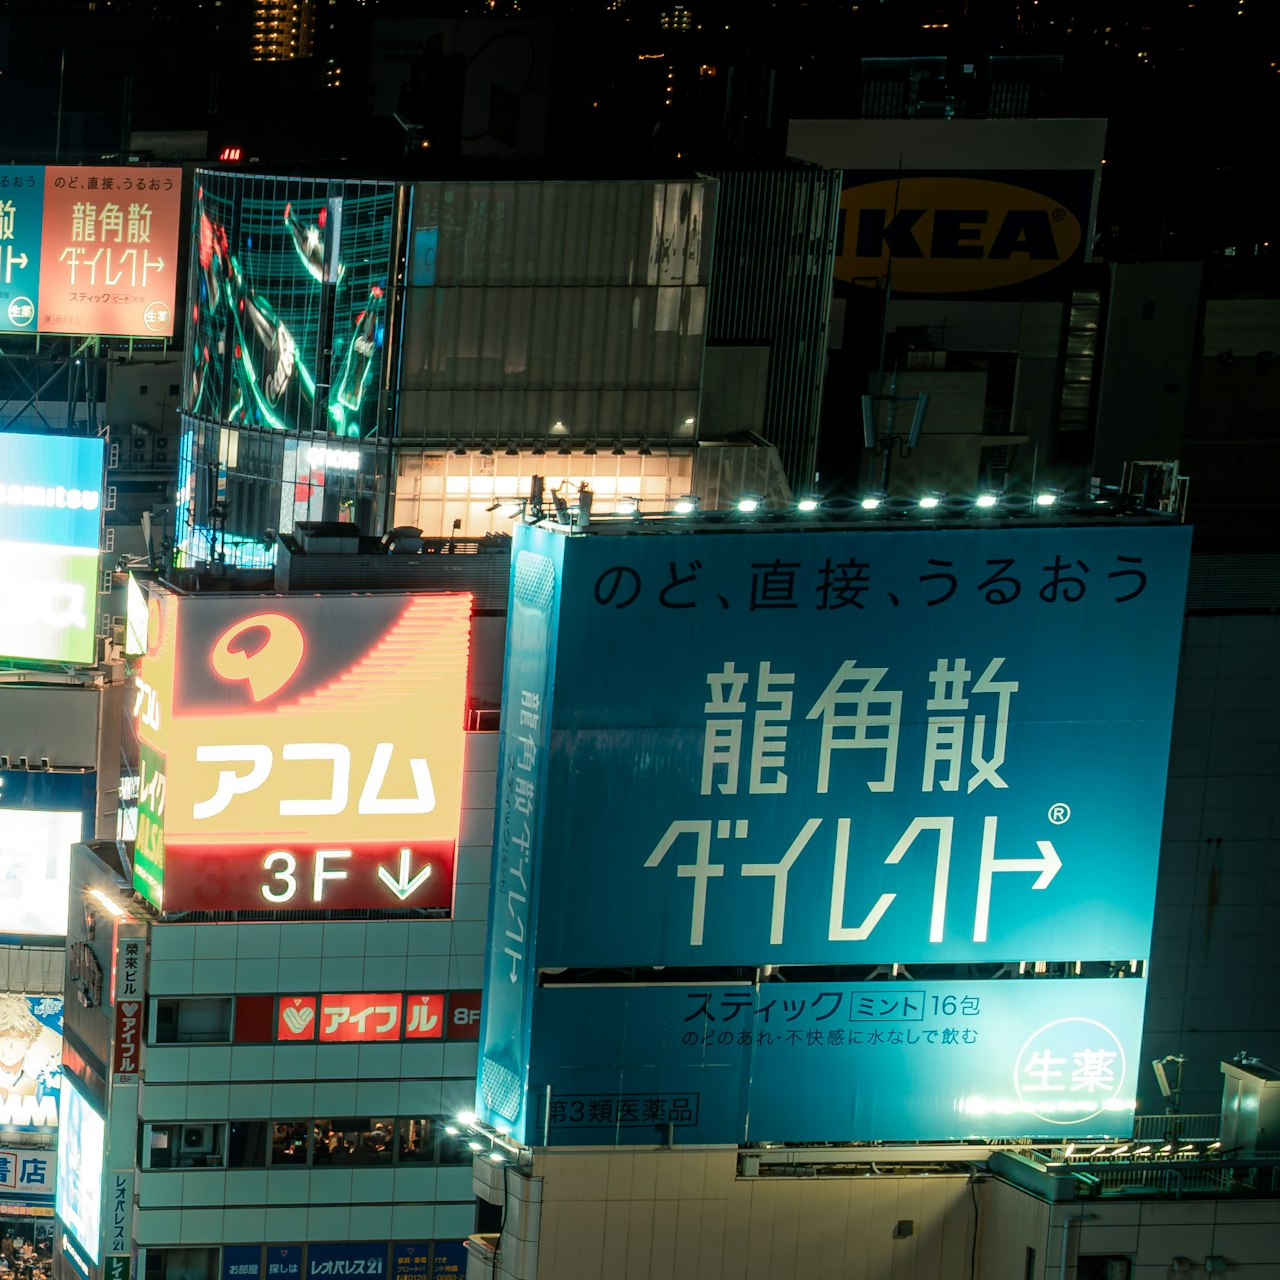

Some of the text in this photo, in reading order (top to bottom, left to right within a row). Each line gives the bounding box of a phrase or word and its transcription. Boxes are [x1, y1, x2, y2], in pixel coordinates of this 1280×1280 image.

[54, 176, 174, 193] のど、直接、うるおう
[71, 202, 153, 244] 龍角散
[58, 245, 164, 288] ダイレクト
[9, 305, 34, 320] 生薬
[69, 292, 111, 304] スティック
[144, 309, 170, 325] 生薬
[592, 554, 1150, 611] のど、直接、うるおう
[133, 677, 160, 731] アコム
[701, 656, 1018, 795] 龍角散
[139, 759, 167, 818] レイク
[193, 742, 436, 820] アコム
[260, 848, 354, 903] 3F
[643, 816, 1062, 946] ダイレクト
[324, 1003, 438, 1034] アイフル
[453, 1007, 480, 1026] 8F
[683, 991, 982, 1024] スティック ミント 16包
[120, 1016, 137, 1073] アイフル
[681, 1026, 980, 1047] のどのあれ・不快感に水なしで飲む
[119, 1075, 133, 1083] 8F
[1022, 1049, 1117, 1094] 生薬
[113, 1175, 128, 1252] レオパレス21
[229, 1263, 258, 1275] お部屋
[269, 1262, 298, 1275] 探しは
[310, 1257, 383, 1276] レオパレス21
